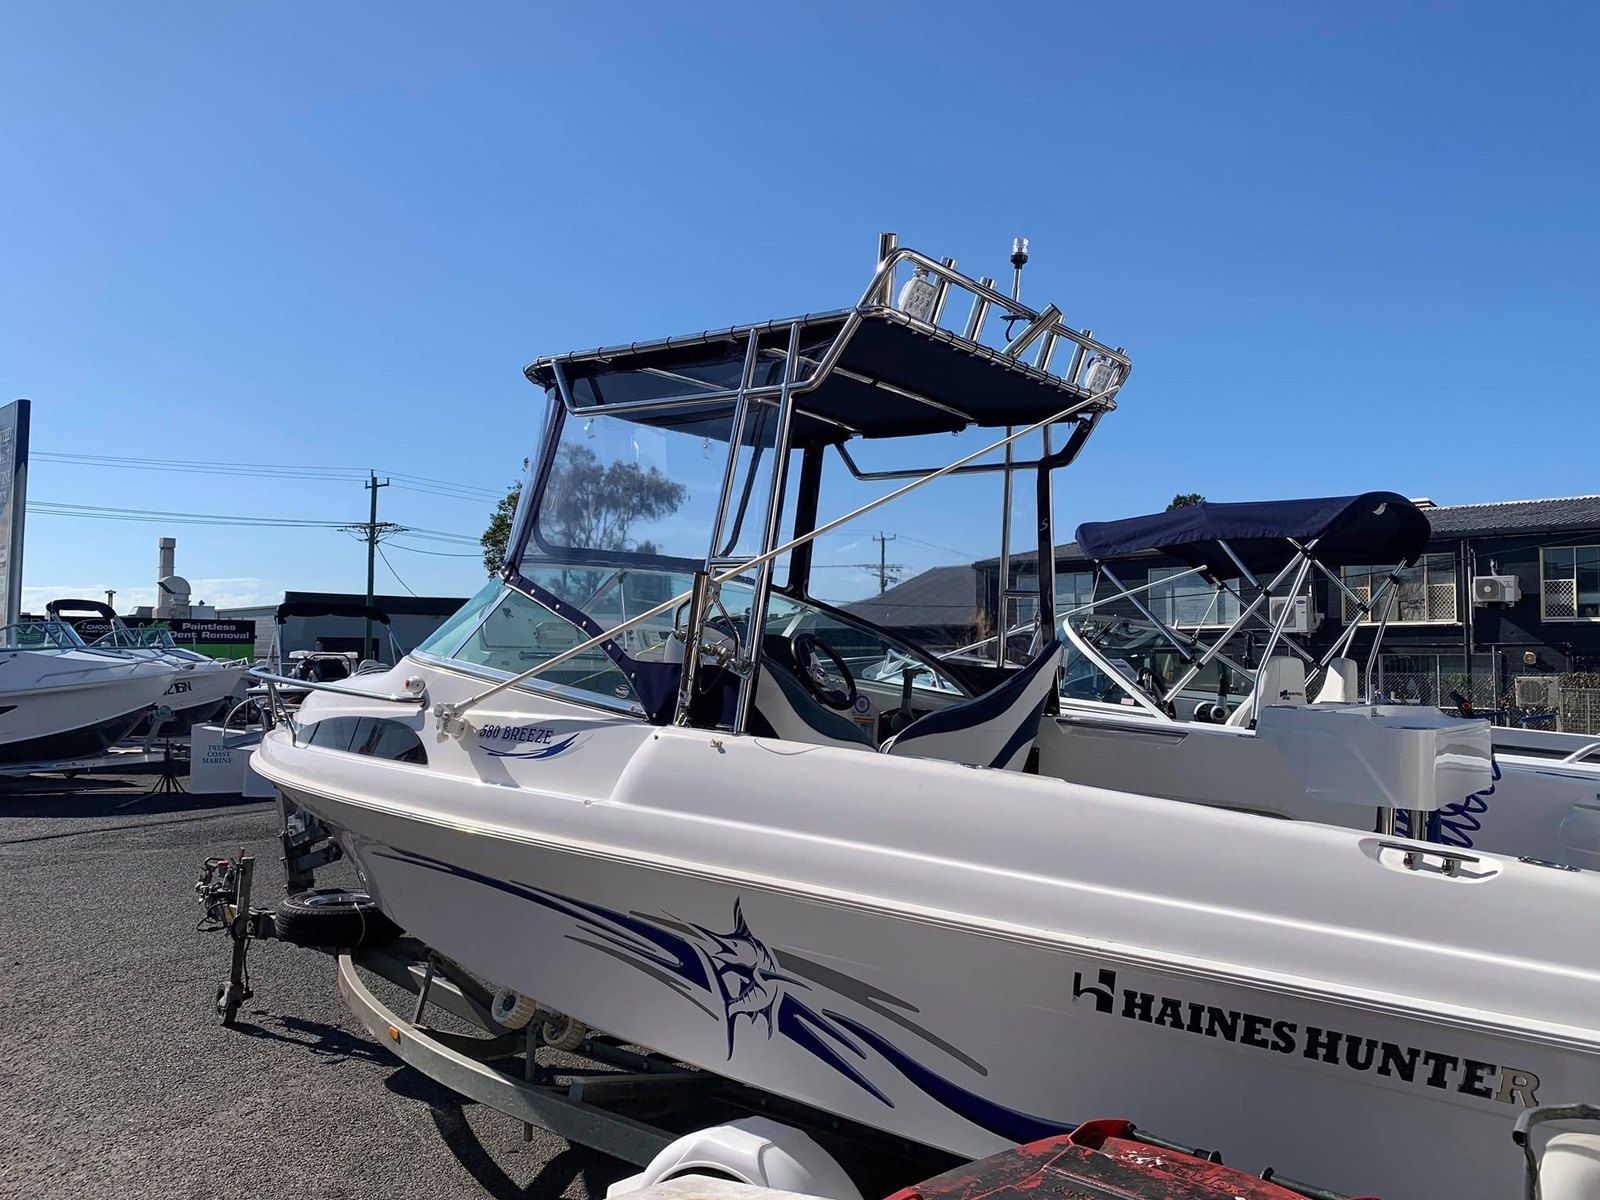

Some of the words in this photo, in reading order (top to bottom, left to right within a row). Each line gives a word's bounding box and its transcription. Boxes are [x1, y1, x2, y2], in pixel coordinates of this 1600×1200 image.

[182, 622, 236, 631] Paintless
[202, 631, 249, 639] Removal
[479, 724, 501, 739] 580
[502, 726, 554, 745] BREEZE
[1121, 988, 1298, 1054] HAINES
[1303, 1025, 1540, 1108] HUNTER
